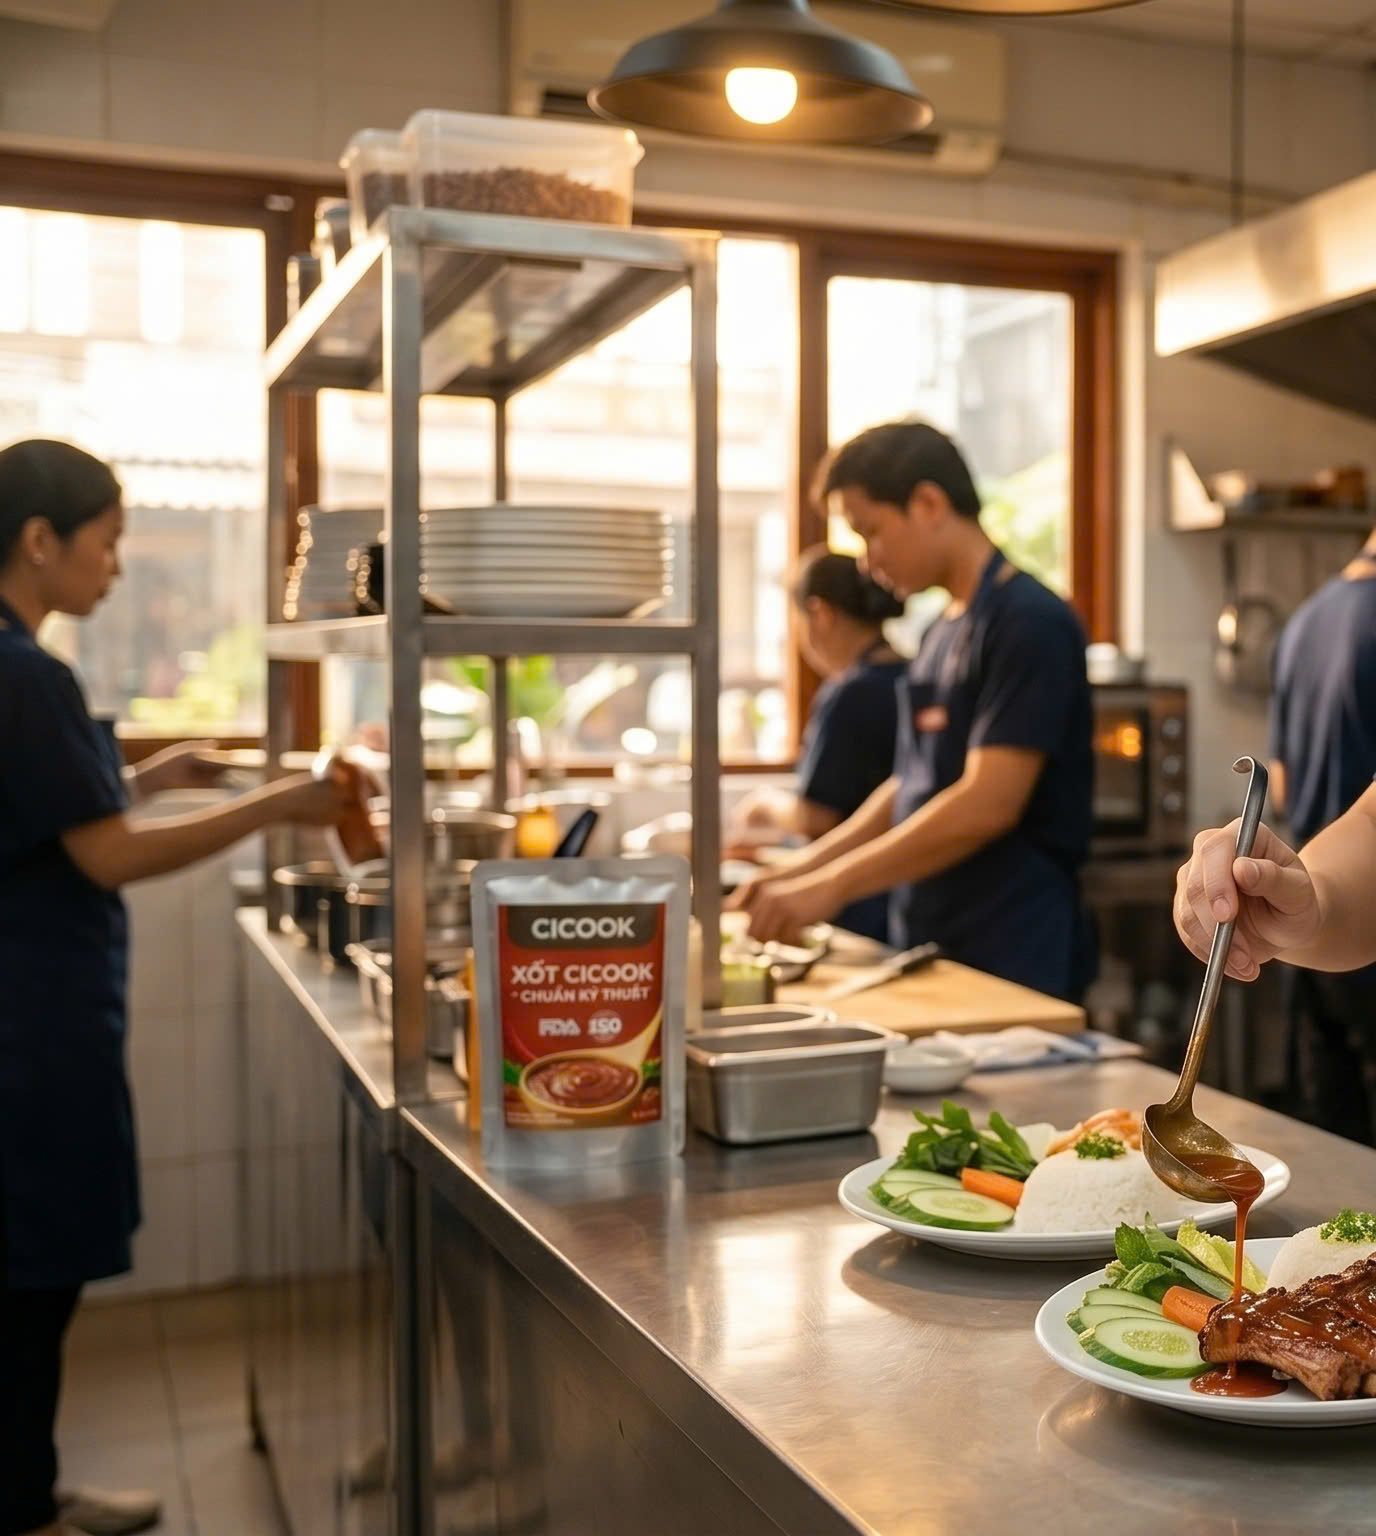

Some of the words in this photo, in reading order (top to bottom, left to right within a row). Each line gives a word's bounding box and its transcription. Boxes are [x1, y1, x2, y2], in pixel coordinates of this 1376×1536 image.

[531, 916, 635, 939] CICOOK
[511, 958, 560, 984] XỐT
[563, 962, 654, 984] CICOOK
[538, 1018, 581, 1037] FDA
[588, 1017, 622, 1036] ISO
